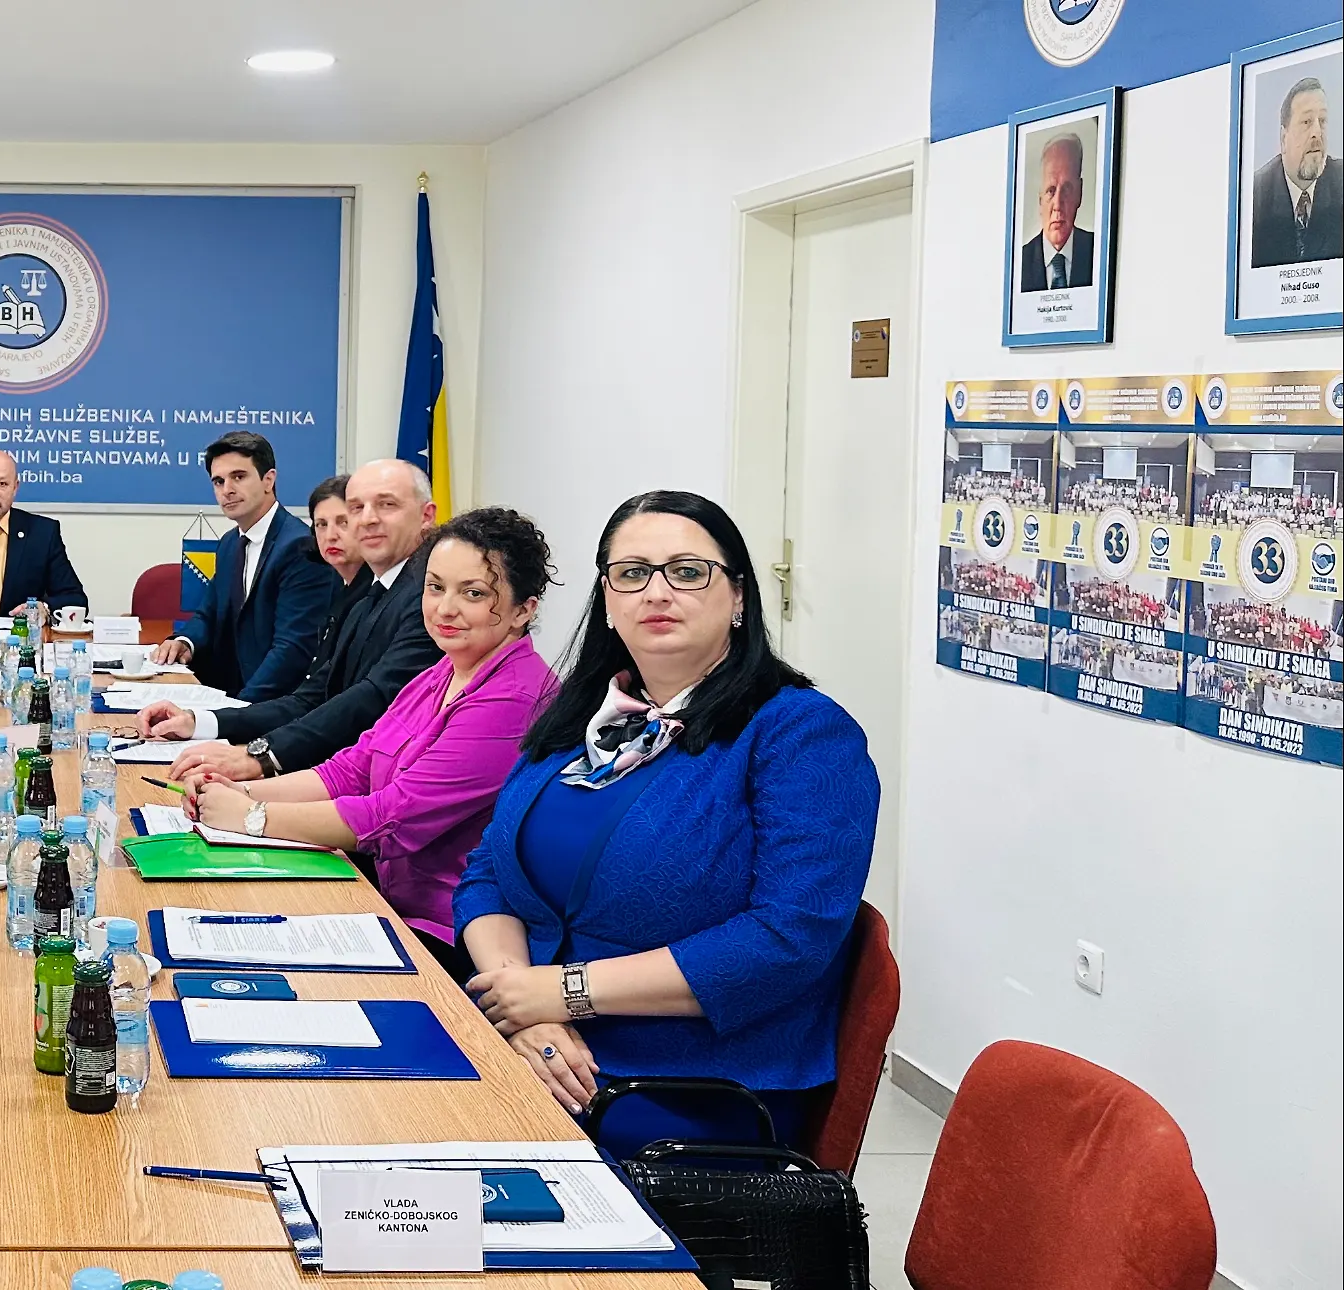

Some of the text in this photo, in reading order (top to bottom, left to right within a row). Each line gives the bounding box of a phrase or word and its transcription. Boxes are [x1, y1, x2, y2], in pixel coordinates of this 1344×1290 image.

[38, 230, 91, 284] NAMJEŠTENIKA
[13, 239, 49, 253] JAVNIM
[49, 250, 84, 309] USTANOVAMA
[1279, 267, 1323, 278] PREDSJEDNIK
[1281, 281, 1320, 292] Nihad Guso
[1, 307, 34, 320] B H
[76, 296, 96, 349] ORGANIMA
[38, 346, 77, 375] DRŽAVNE
[40, 404, 154, 423] SLUŽBENIKA
[162, 409, 166, 423] I
[174, 406, 315, 425] NAMJEŠTENIKA
[0, 424, 82, 443] DRŽAVNE
[89, 426, 165, 446] SLUŽBE,
[48, 450, 170, 465] USTANOVAMA
[178, 451, 189, 465] U
[983, 514, 1005, 541] 33
[1105, 527, 1129, 557] 33
[1253, 541, 1283, 577] 33
[954, 593, 1036, 622] U SINDIKATU JE SNAGA
[1071, 615, 1165, 647] U SINDIKATU JE SNAGA
[961, 645, 1018, 672] DAN SINDIKATA
[1207, 640, 1331, 680] U SINDIKATU JE SNAGA
[1079, 674, 1143, 703] DAN SINDIKATA
[1219, 707, 1304, 743] DAN SINDIKATA
[1218, 725, 1256, 745] 18.05.1990
[1260, 736, 1303, 756] 18.05.2023
[344, 1209, 458, 1220] ZENIČKO-DOBOJSKOG
[384, 1199, 418, 1208] VLADA
[378, 1223, 429, 1232] KANTONA
